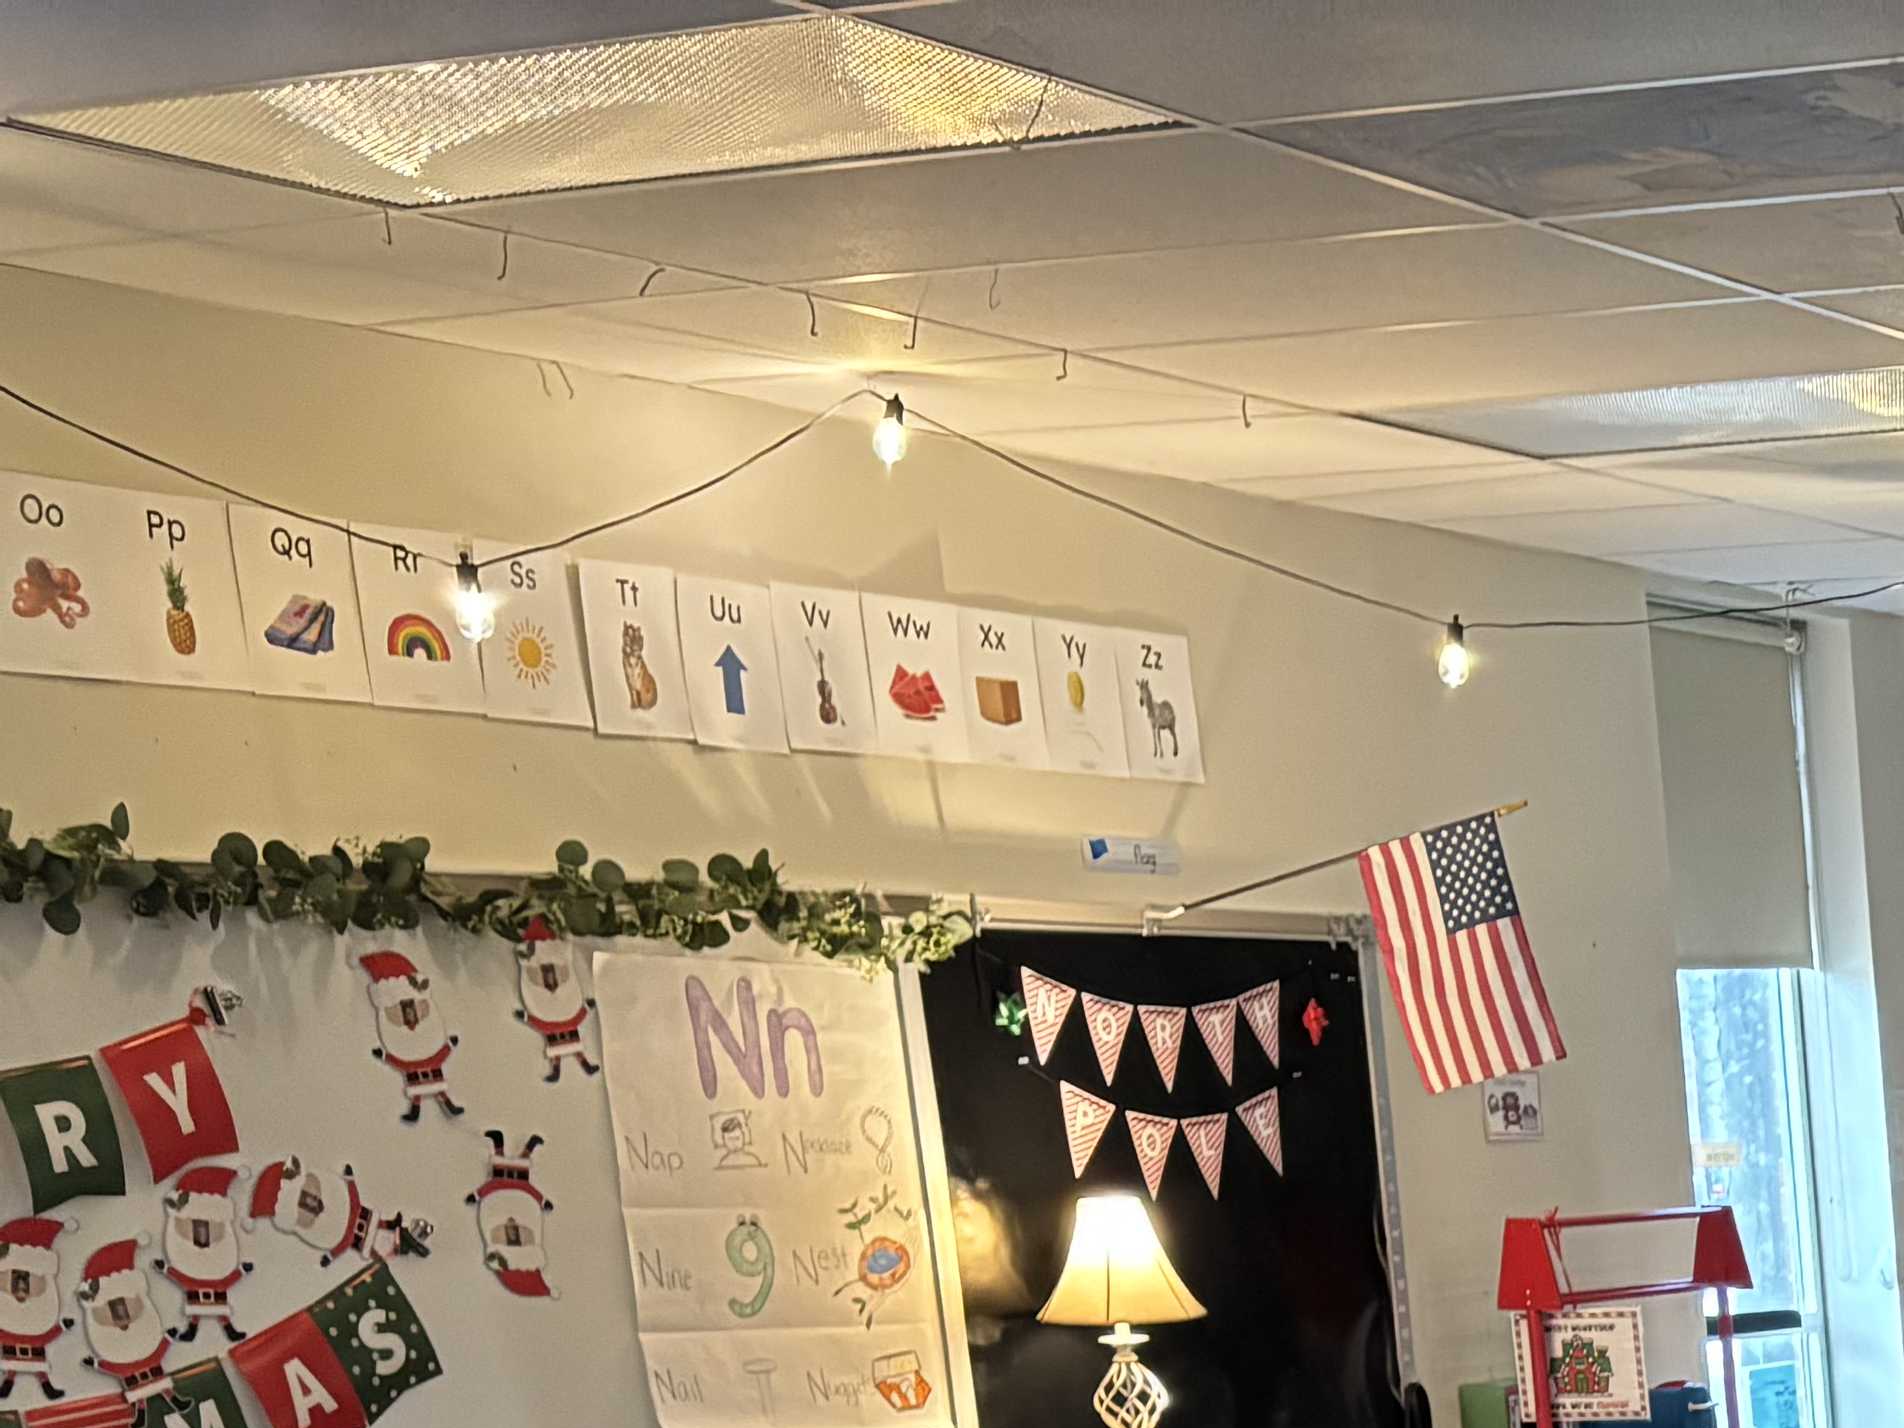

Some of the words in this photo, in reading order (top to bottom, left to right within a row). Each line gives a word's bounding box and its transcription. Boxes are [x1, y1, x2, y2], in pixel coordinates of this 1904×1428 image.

[19, 493, 65, 528] Oo
[146, 509, 187, 550] Pp
[269, 528, 313, 567] Qq
[392, 545, 425, 574] Rr
[509, 561, 538, 591] Ss
[615, 578, 640, 607] Tt
[709, 594, 742, 625] Uu
[800, 601, 831, 629] Vv
[887, 611, 931, 640] Ww
[979, 623, 1007, 651] Xx
[1061, 634, 1088, 667] Yy
[1140, 644, 1165, 671] Zz
[685, 975, 824, 1100] Nn
[1037, 986, 1272, 1048] NORTH
[624, 1132, 684, 1176] Nap
[1075, 1101, 1273, 1157] POLE
[637, 1248, 694, 1292] Nine
[791, 1245, 849, 1286] Nest
[653, 1367, 705, 1406] Nail
